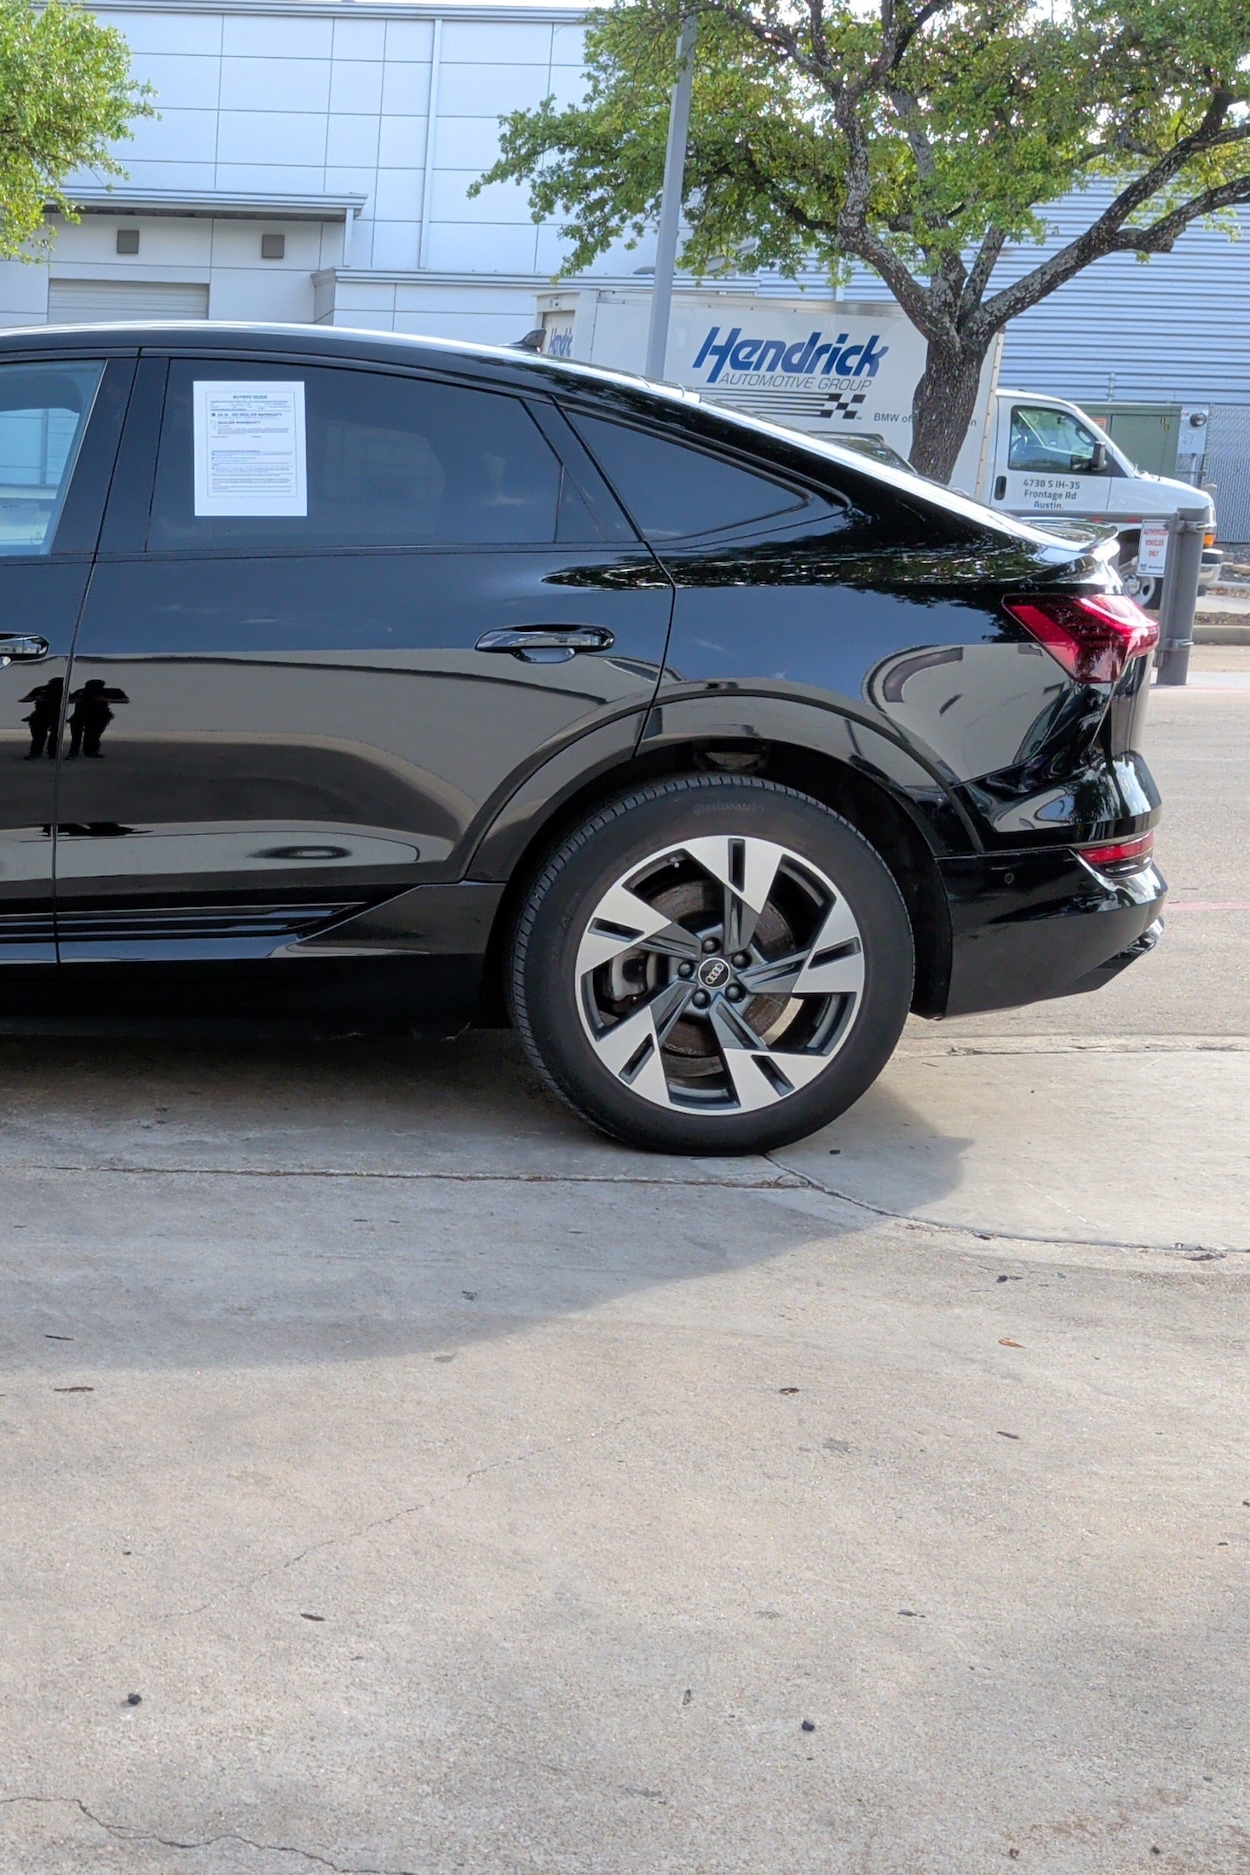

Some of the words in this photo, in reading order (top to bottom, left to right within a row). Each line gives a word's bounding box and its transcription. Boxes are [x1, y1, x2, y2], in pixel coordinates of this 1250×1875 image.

[692, 326, 889, 384] Hendrick
[718, 372, 816, 390] AUTOMOTIVE
[817, 377, 873, 392] GROUP
[873, 412, 899, 422] BMW
[901, 414, 912, 423] of
[1023, 478, 1046, 488] 4738
[1047, 479, 1054, 488] S
[1023, 489, 1063, 502] Frontage
[1065, 491, 1077, 500] Rd
